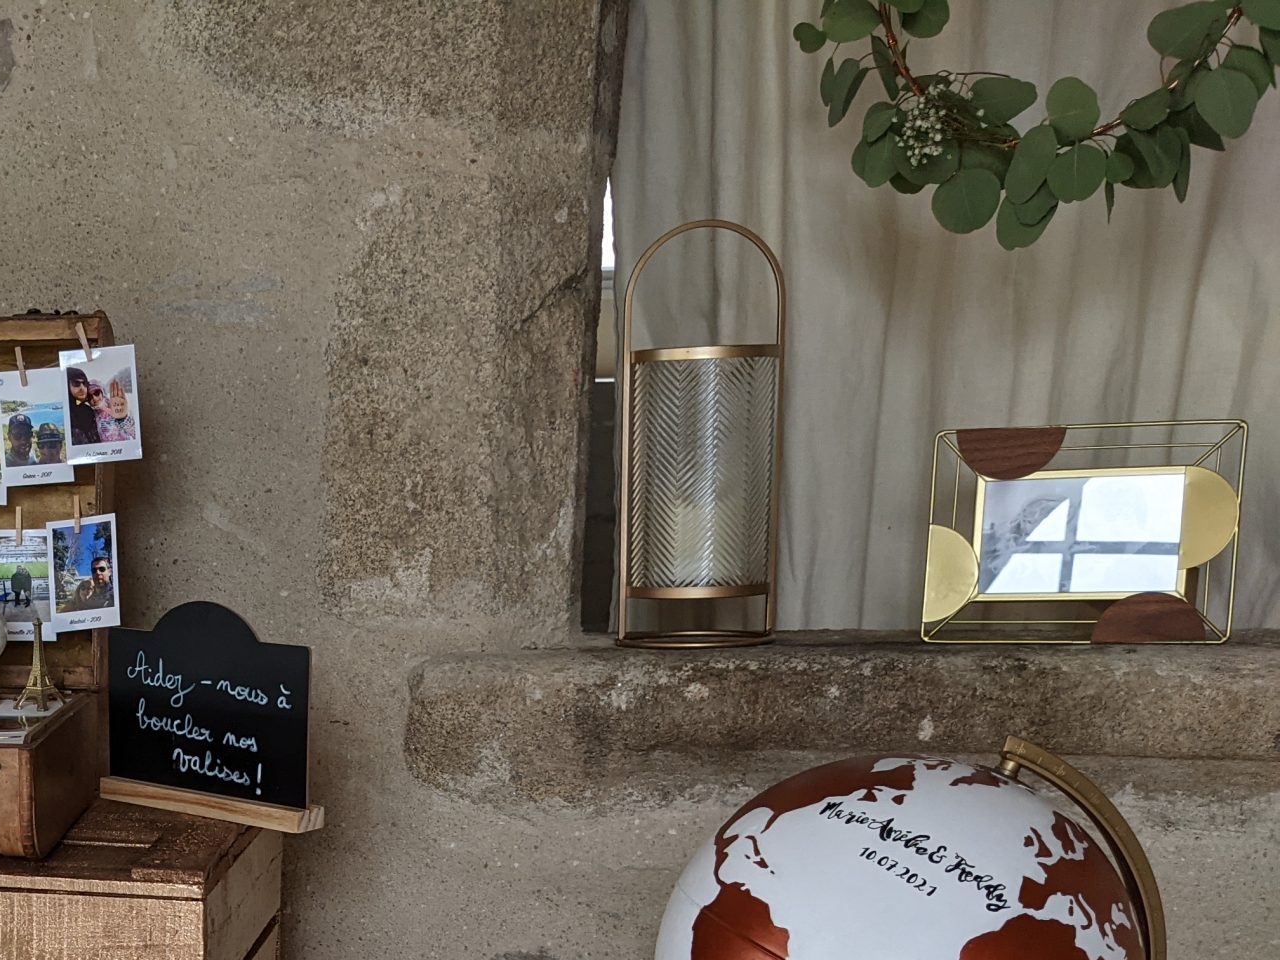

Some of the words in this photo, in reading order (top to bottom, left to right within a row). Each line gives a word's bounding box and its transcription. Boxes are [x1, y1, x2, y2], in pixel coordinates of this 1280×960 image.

[277, 684, 292, 709] à
[136, 698, 214, 743] boucler
[222, 732, 258, 752] nos
[859, 847, 938, 897] 10.07.2021
[928, 845, 948, 864] &
[944, 853, 1012, 912] Freddy
